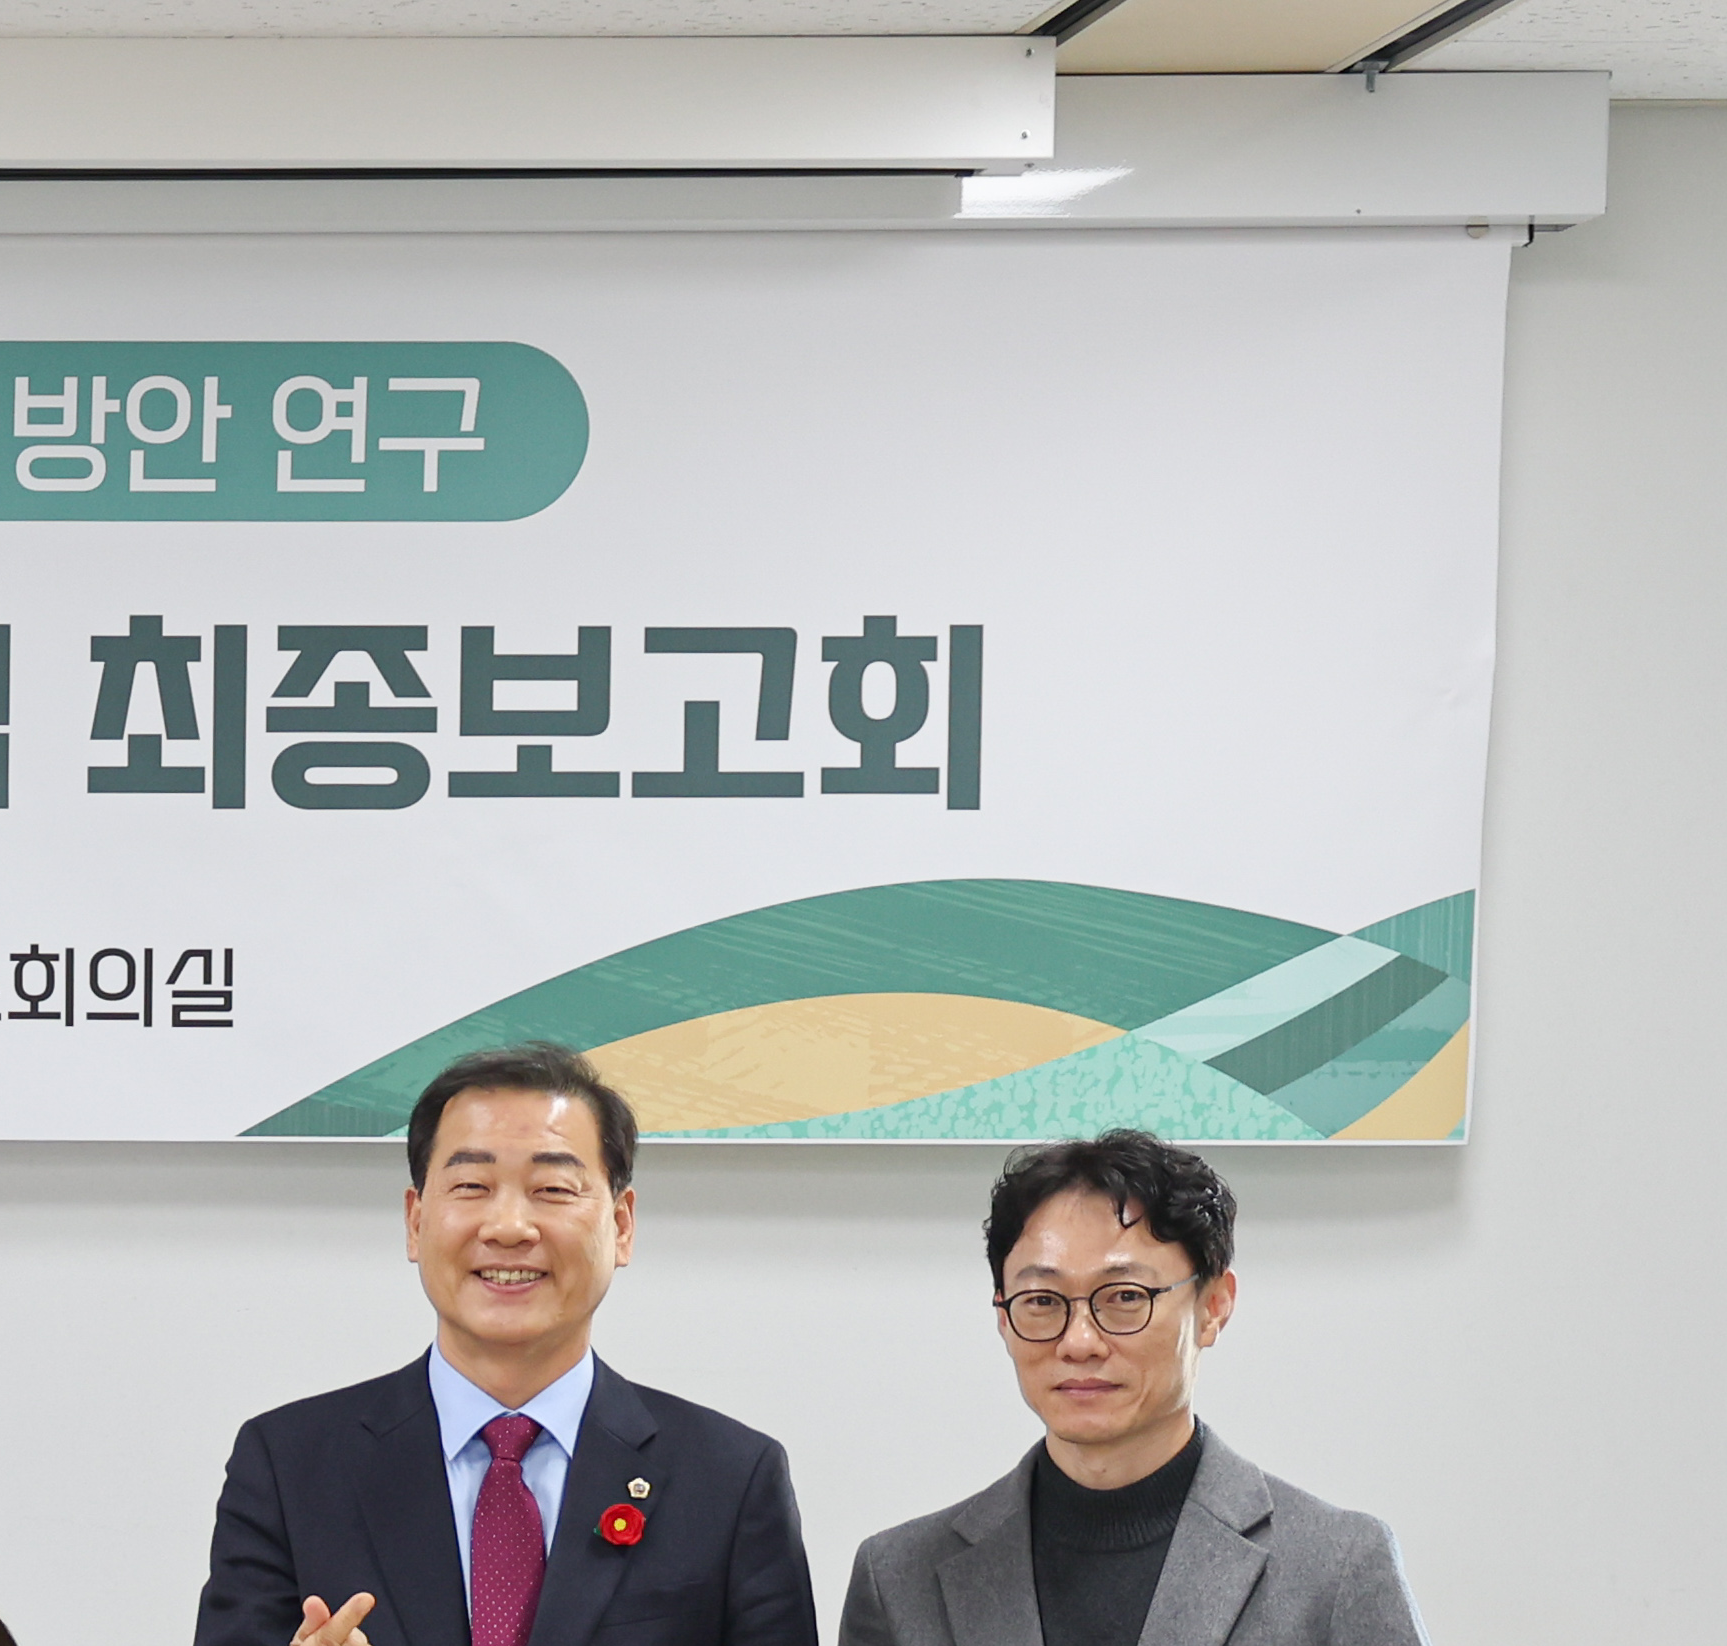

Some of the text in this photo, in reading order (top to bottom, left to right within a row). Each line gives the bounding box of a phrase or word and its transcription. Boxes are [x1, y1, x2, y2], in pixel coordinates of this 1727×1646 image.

[14, 376, 232, 491] 방안
[273, 376, 484, 492] 연구
[87, 615, 983, 810] 최종보고회
